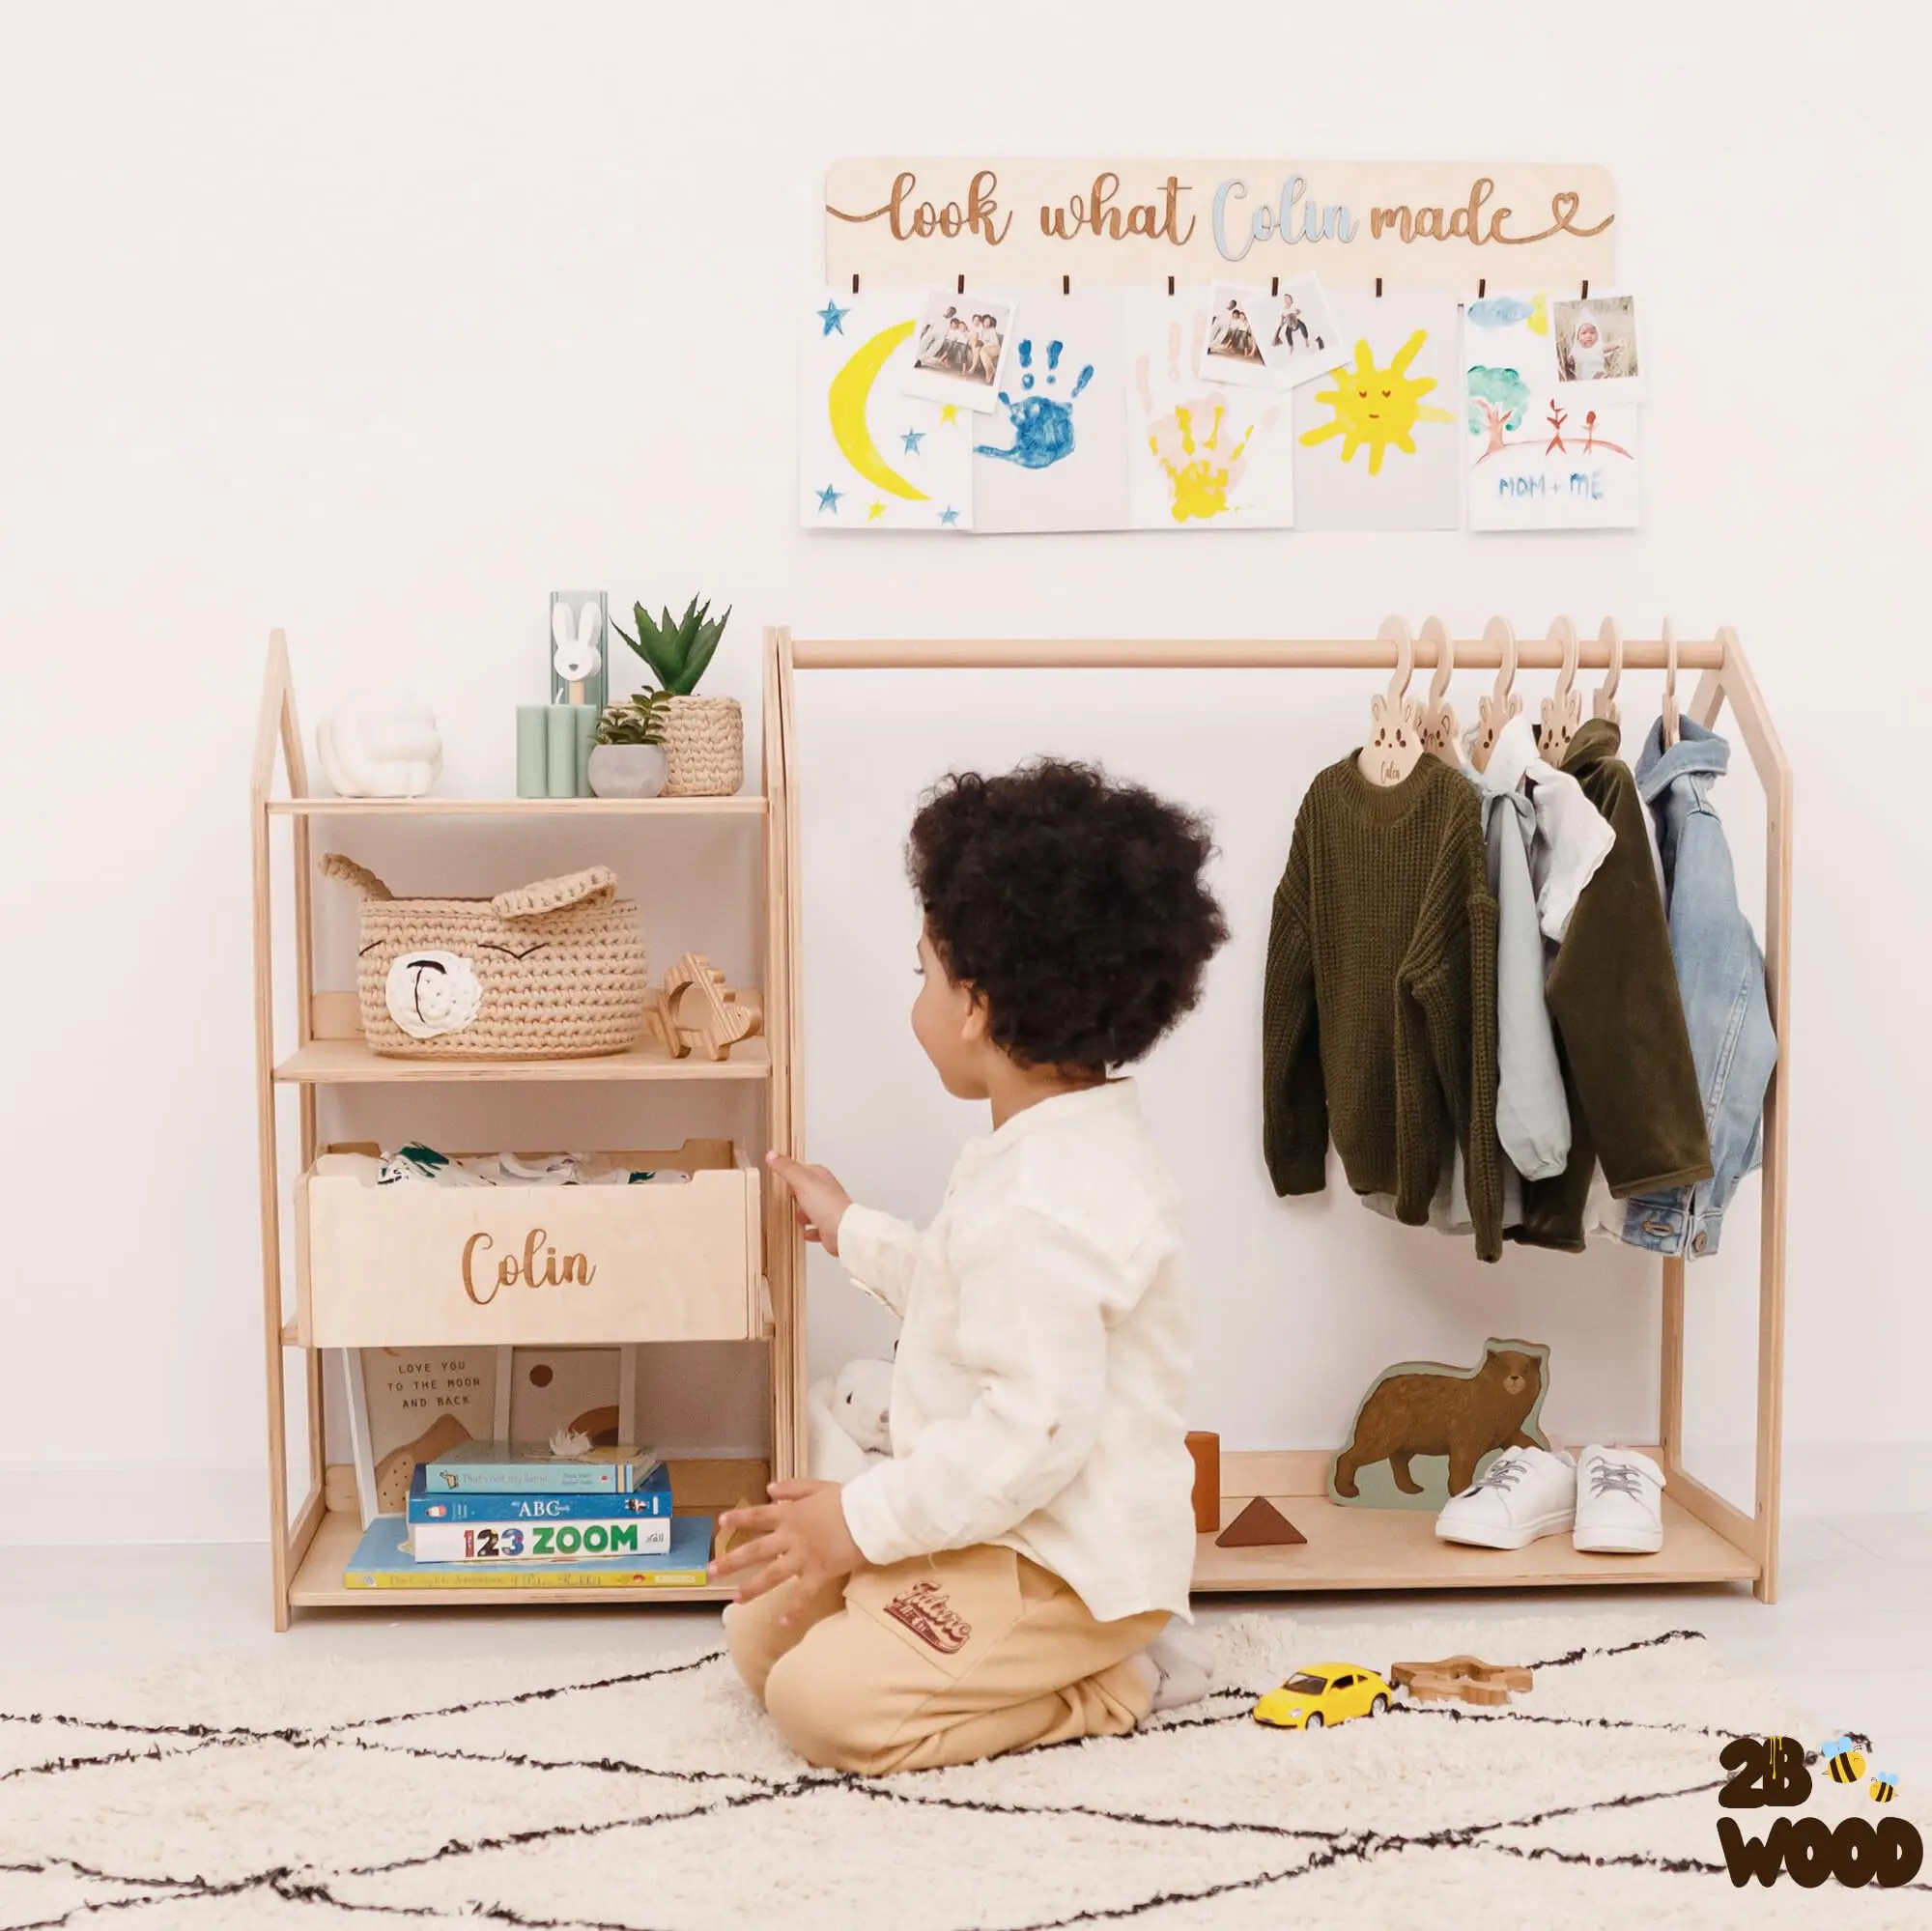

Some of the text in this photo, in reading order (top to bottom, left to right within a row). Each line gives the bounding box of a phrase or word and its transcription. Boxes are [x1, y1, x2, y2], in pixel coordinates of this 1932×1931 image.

[874, 170, 1546, 262] look what Colin made
[1498, 473, 1546, 498] MOM
[1569, 470, 1604, 500] ME
[461, 1228, 597, 1306] Colin
[398, 1360, 467, 1375] LOVE YOU
[387, 1377, 481, 1393] TO THE MOON
[402, 1396, 471, 1409] AND BACK
[517, 1499, 560, 1518] ABC
[463, 1523, 639, 1558] 123 ZOOM
